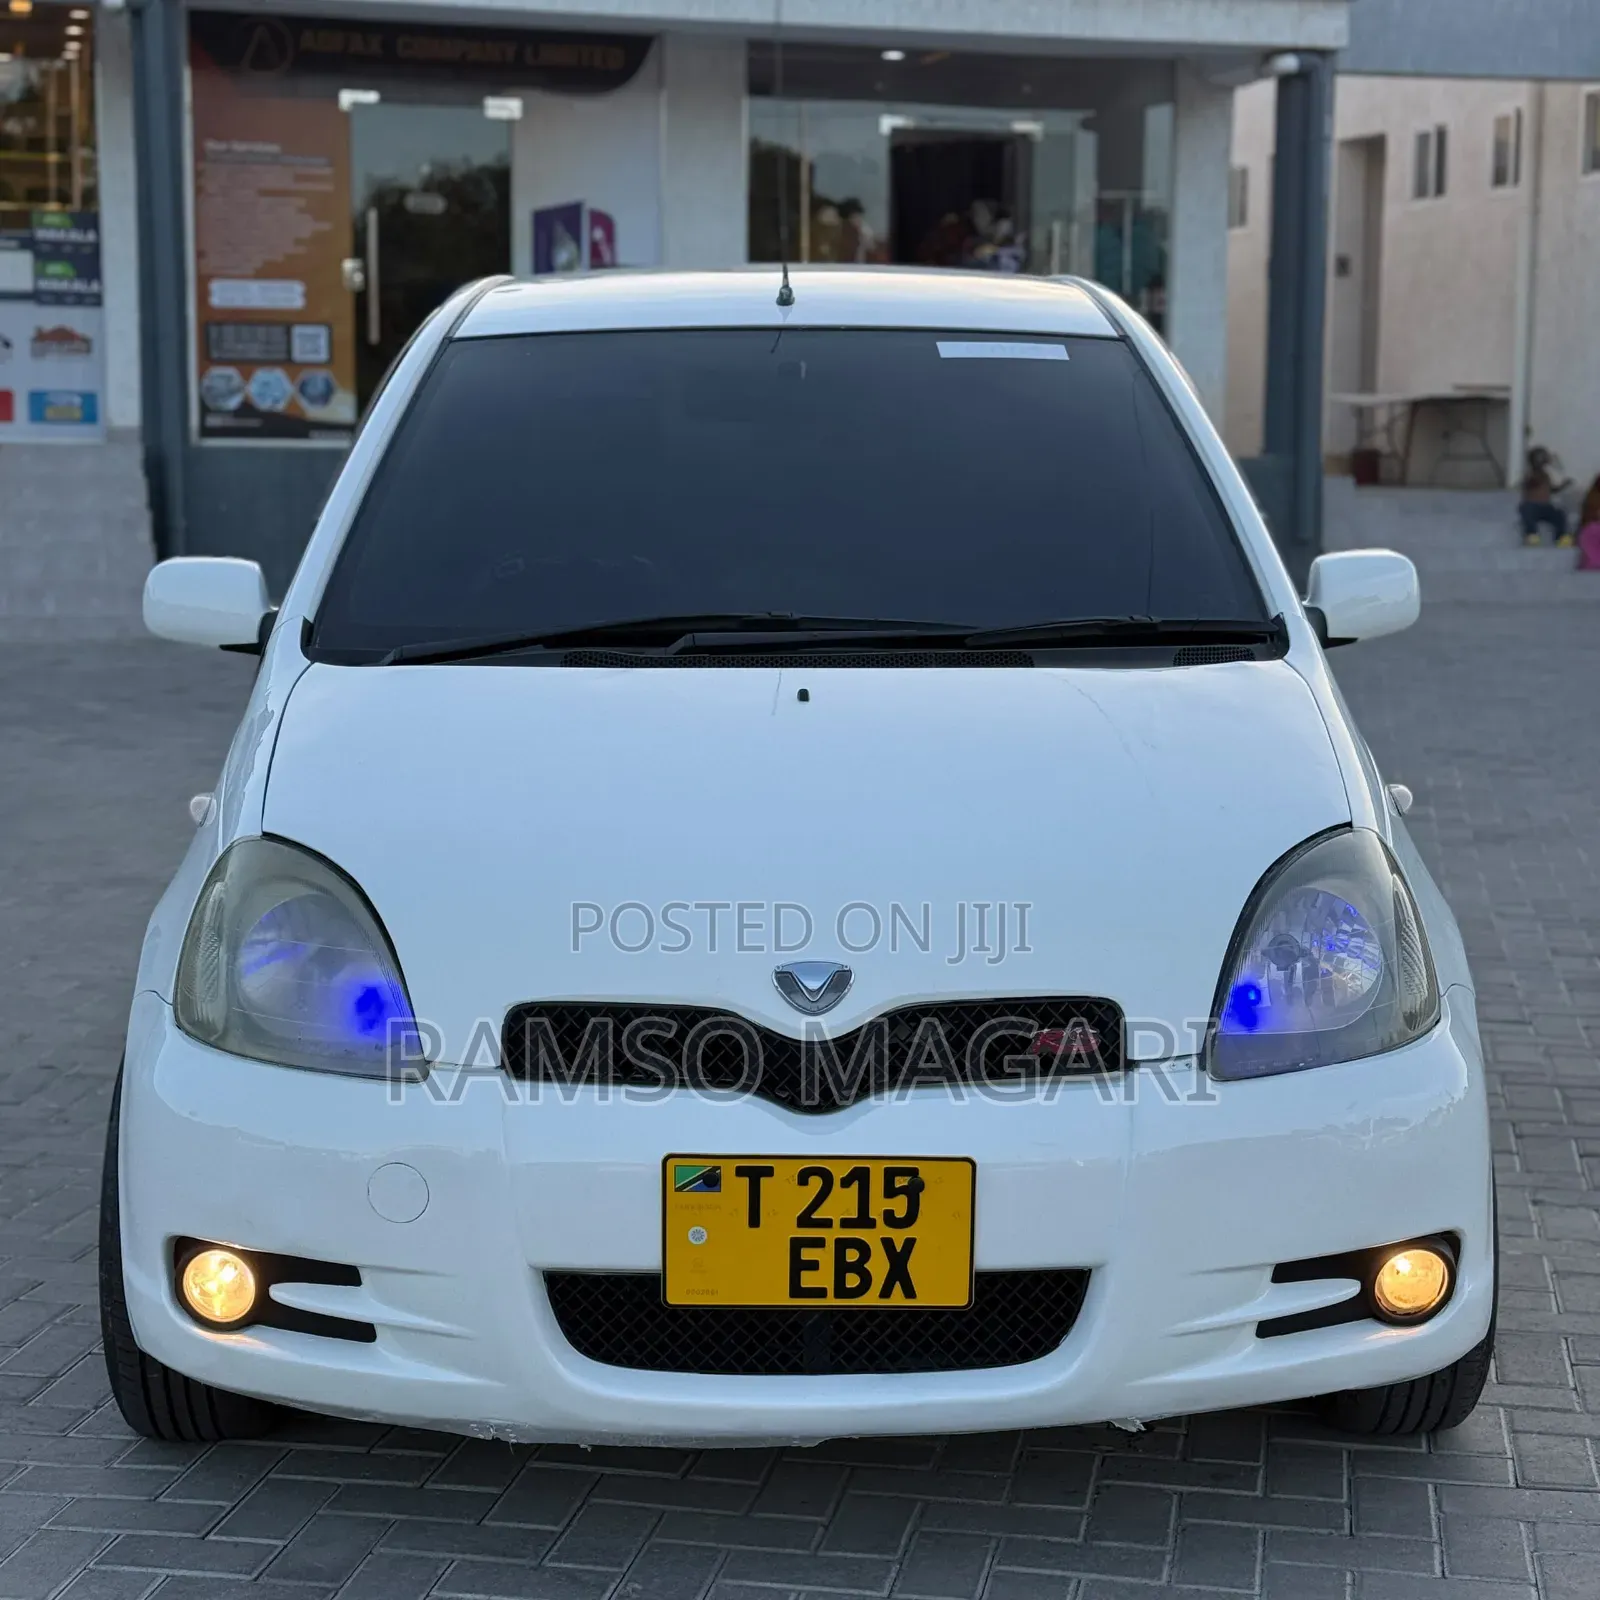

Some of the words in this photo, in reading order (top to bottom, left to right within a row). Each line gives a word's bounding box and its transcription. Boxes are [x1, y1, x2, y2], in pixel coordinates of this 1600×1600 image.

[523, 42, 626, 71] LIMITED
[734, 1165, 775, 1229] T
[796, 1165, 924, 1230] 215
[788, 1236, 918, 1300] EBX
